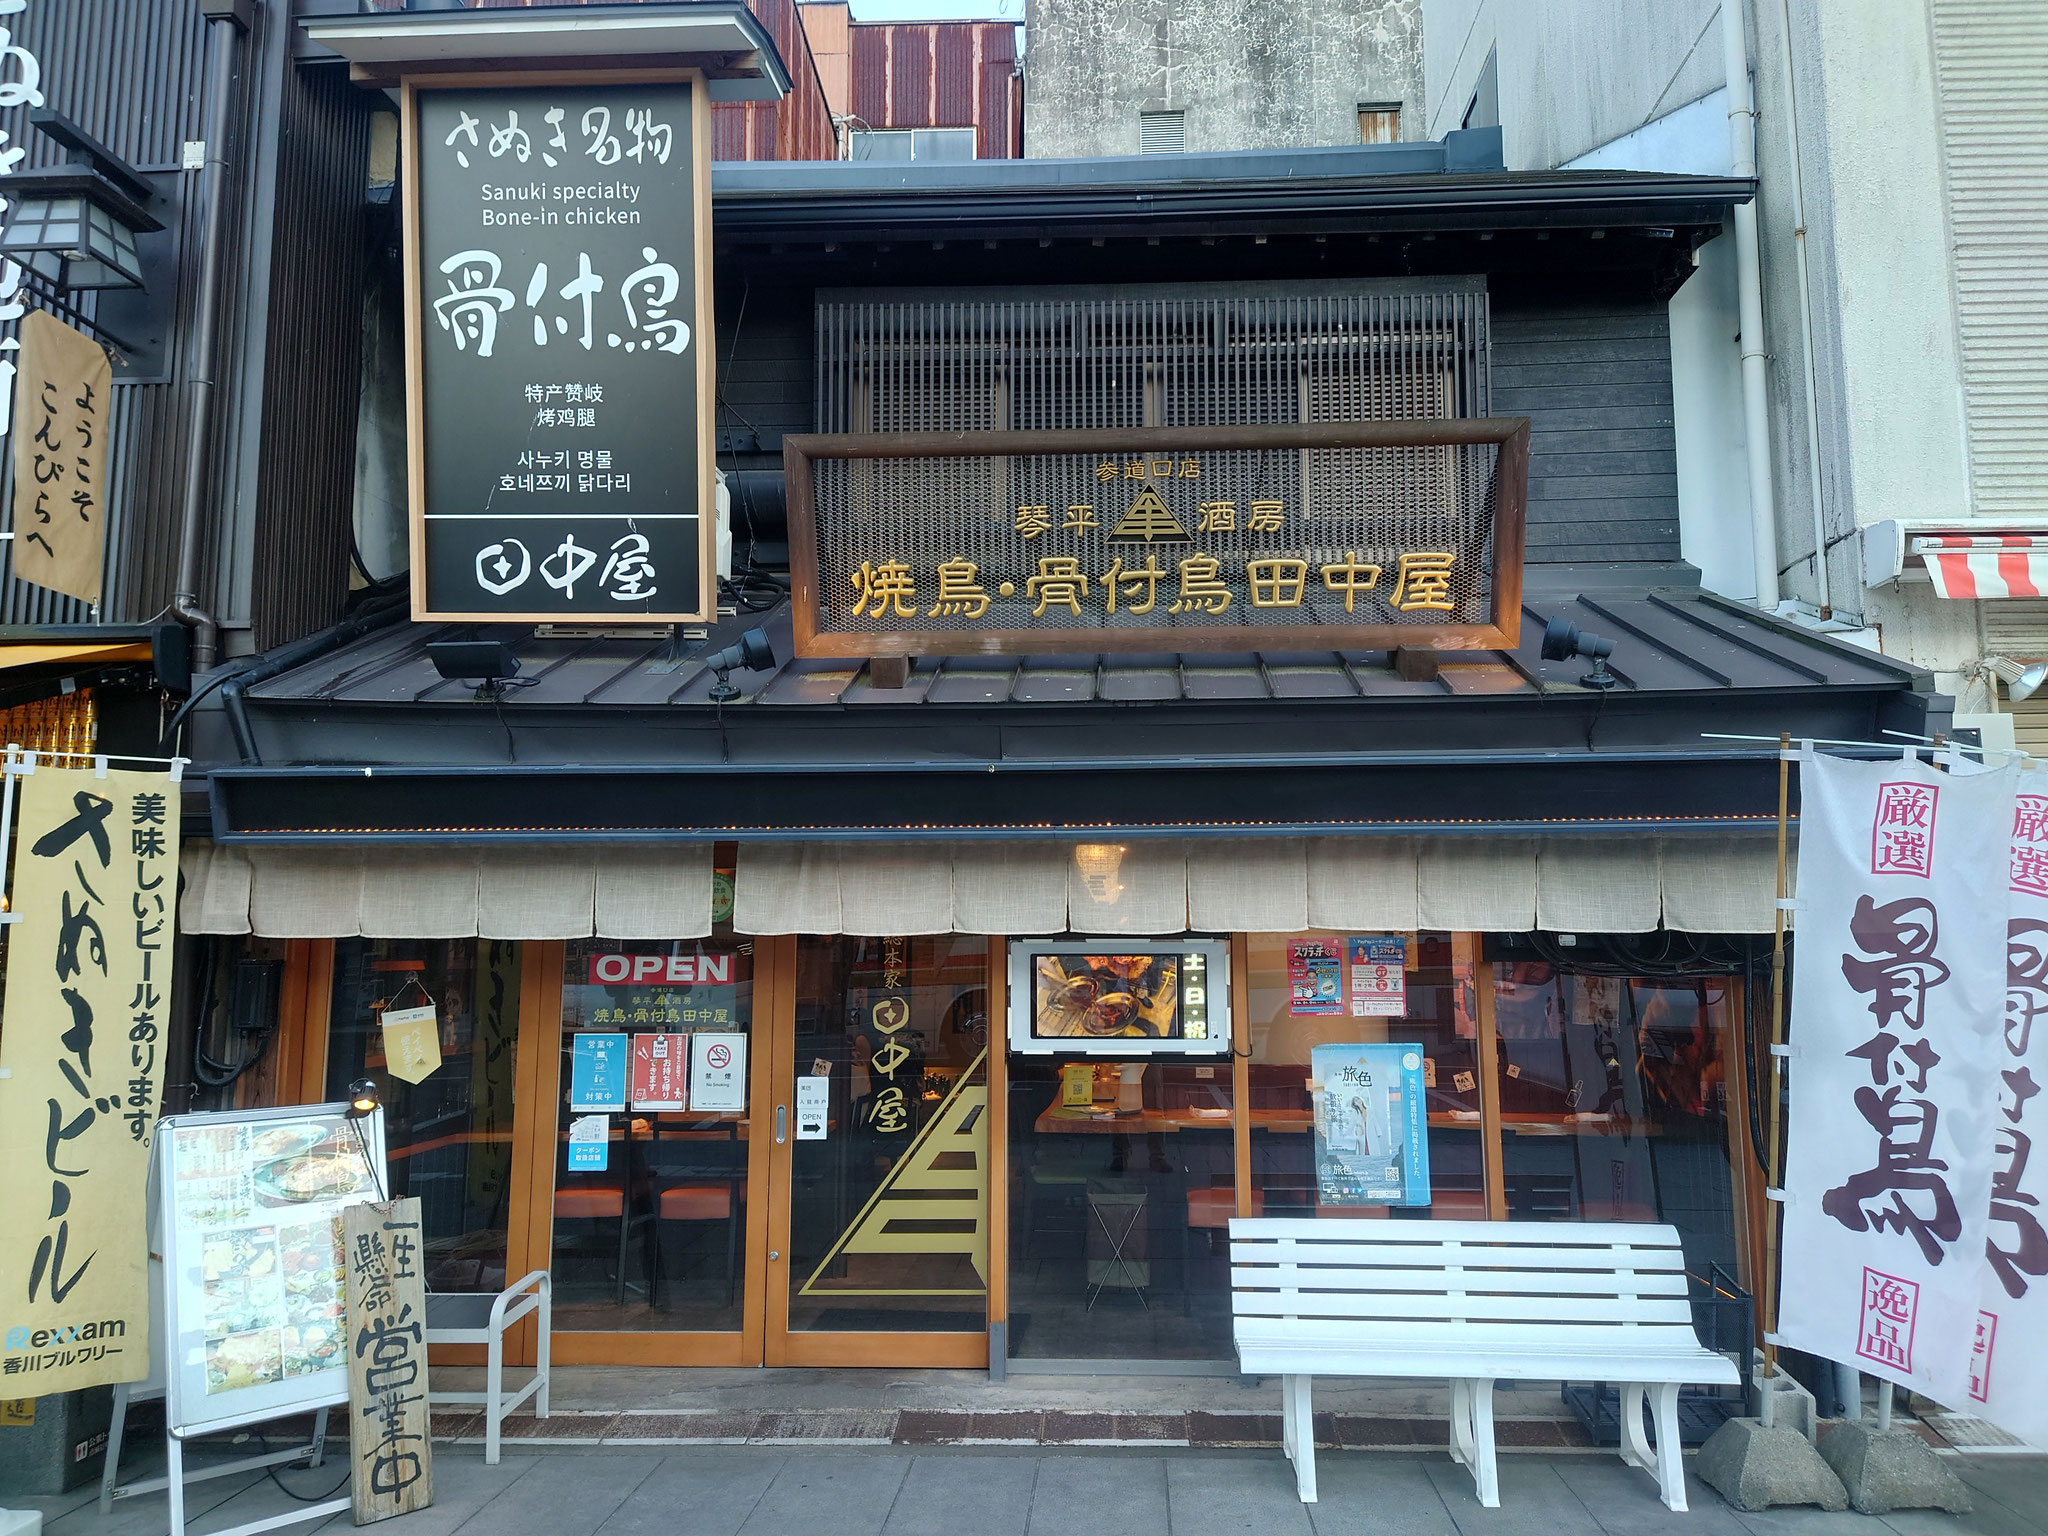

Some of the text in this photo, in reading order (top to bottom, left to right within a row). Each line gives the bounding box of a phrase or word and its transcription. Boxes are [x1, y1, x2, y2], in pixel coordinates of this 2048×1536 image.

[481, 181, 641, 203] Sanuki specialty
[482, 207, 641, 226] Bone-in chicken
[433, 246, 690, 357] 骨付鳥
[525, 383, 604, 403] 特产赞岐
[536, 408, 596, 427] 烤鸡腿
[26, 380, 64, 559] こんぴらへ
[71, 381, 96, 523] ようこそ
[517, 450, 613, 469] 사누키 명물
[1095, 458, 1201, 482] 参道口店
[500, 473, 631, 493] 호네쯔끼 닭다리
[1014, 501, 1285, 539] 琴平 酒房
[475, 533, 657, 601] 田中屋
[1876, 784, 1928, 876] 厳選
[123, 792, 167, 1148] 美味しいビールあります。
[596, 955, 728, 982] OPEN
[28, 790, 121, 1303] さぬきビール
[588, 1040, 614, 1049] 営業中
[661, 1059, 671, 1100] お持ち帰り
[869, 996, 910, 1132] 田中屋
[1342, 1065, 1372, 1087] 旅色
[1822, 894, 1963, 1266] 骨付鳥
[5, 1319, 125, 1351] Rexxam
[1865, 1274, 1910, 1365] 逸品
[3, 1345, 123, 1375] 香川ブルワリー
[355, 1303, 424, 1504] 営業中
